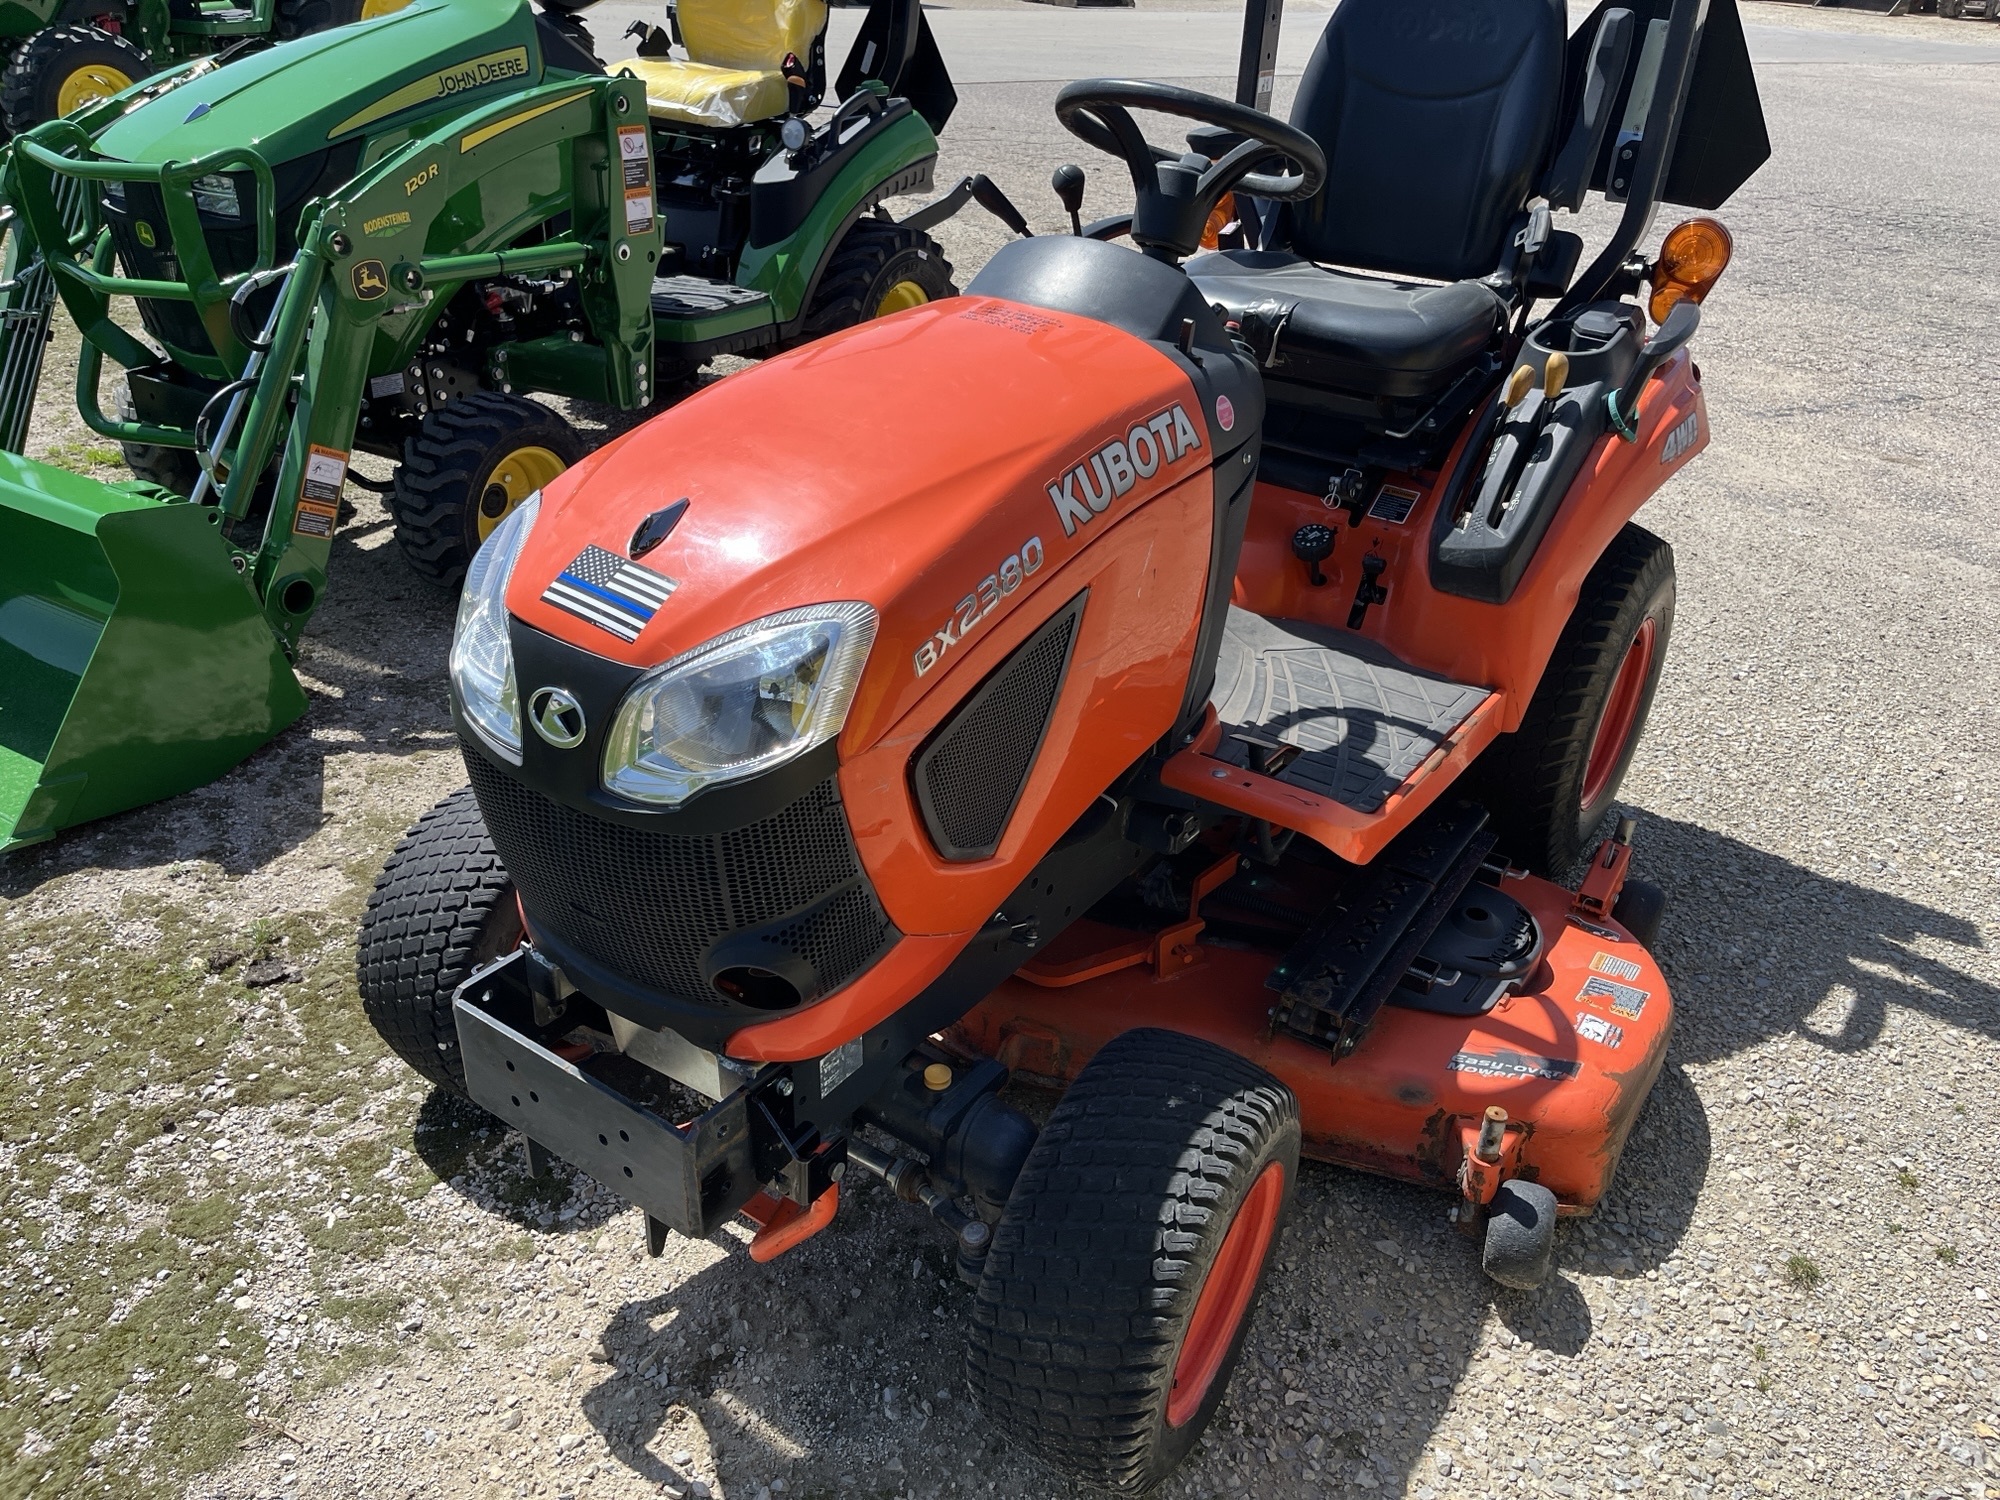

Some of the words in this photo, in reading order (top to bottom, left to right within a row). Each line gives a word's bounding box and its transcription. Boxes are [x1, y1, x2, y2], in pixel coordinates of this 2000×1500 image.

[438, 69, 477, 95] JOHN
[477, 58, 524, 82] DEERE
[404, 171, 428, 197] 120
[428, 163, 439, 179] R
[363, 211, 412, 235] BODENSTEINER
[1661, 411, 1698, 464] 4WD
[1048, 403, 1202, 538] KUBOTA
[913, 536, 1045, 679] BX2380
